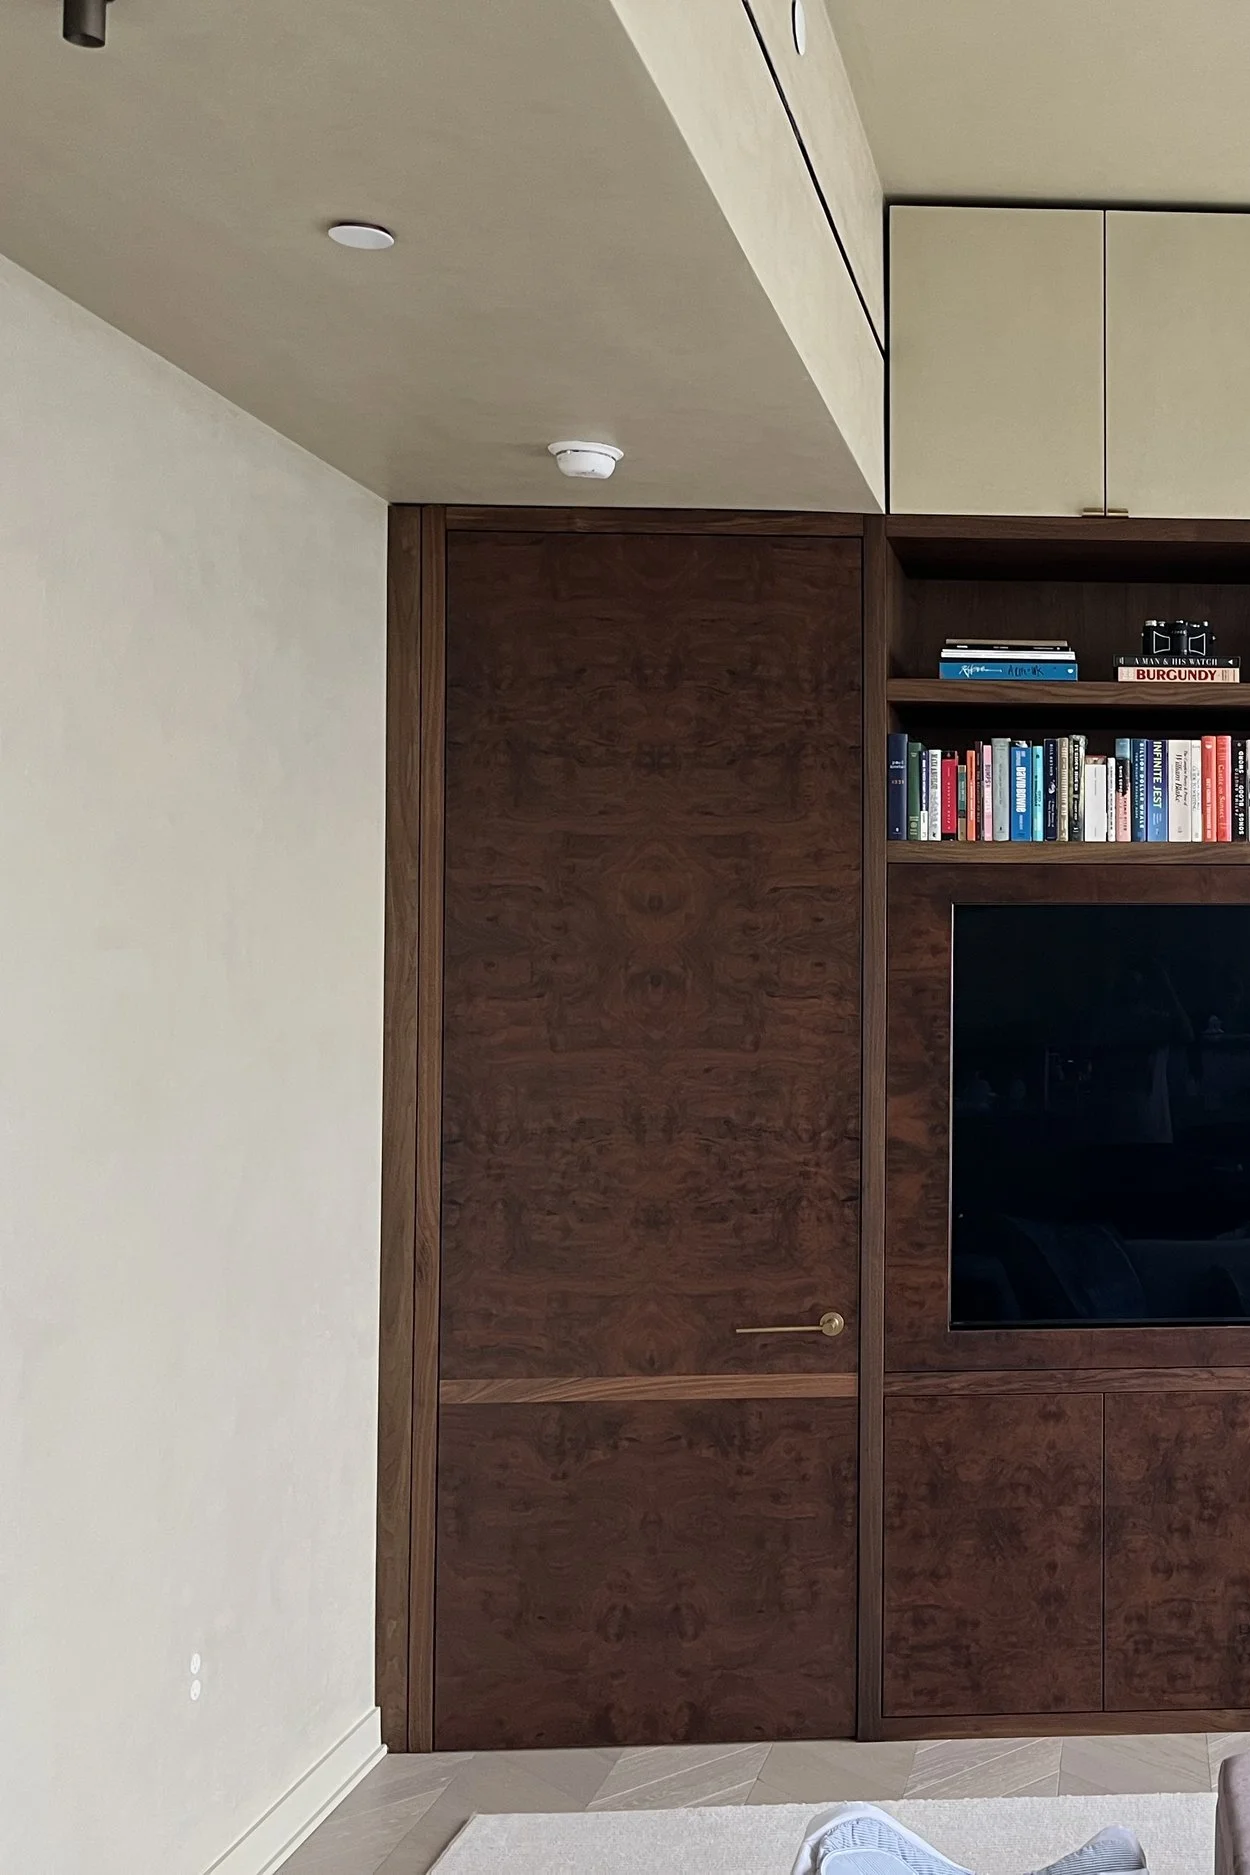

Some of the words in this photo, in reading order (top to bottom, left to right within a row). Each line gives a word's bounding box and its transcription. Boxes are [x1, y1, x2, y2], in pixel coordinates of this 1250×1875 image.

[1135, 657, 1139, 665] A
[1142, 657, 1160, 665] MAN
[1189, 658, 1217, 666] WATCH
[1136, 669, 1217, 681] BURGUNDY
[1153, 741, 1162, 783] INFINITE
[1175, 754, 1183, 781] William
[1153, 785, 1162, 808] JEST
[1175, 782, 1183, 803] Blake
[1218, 786, 1223, 794] on
